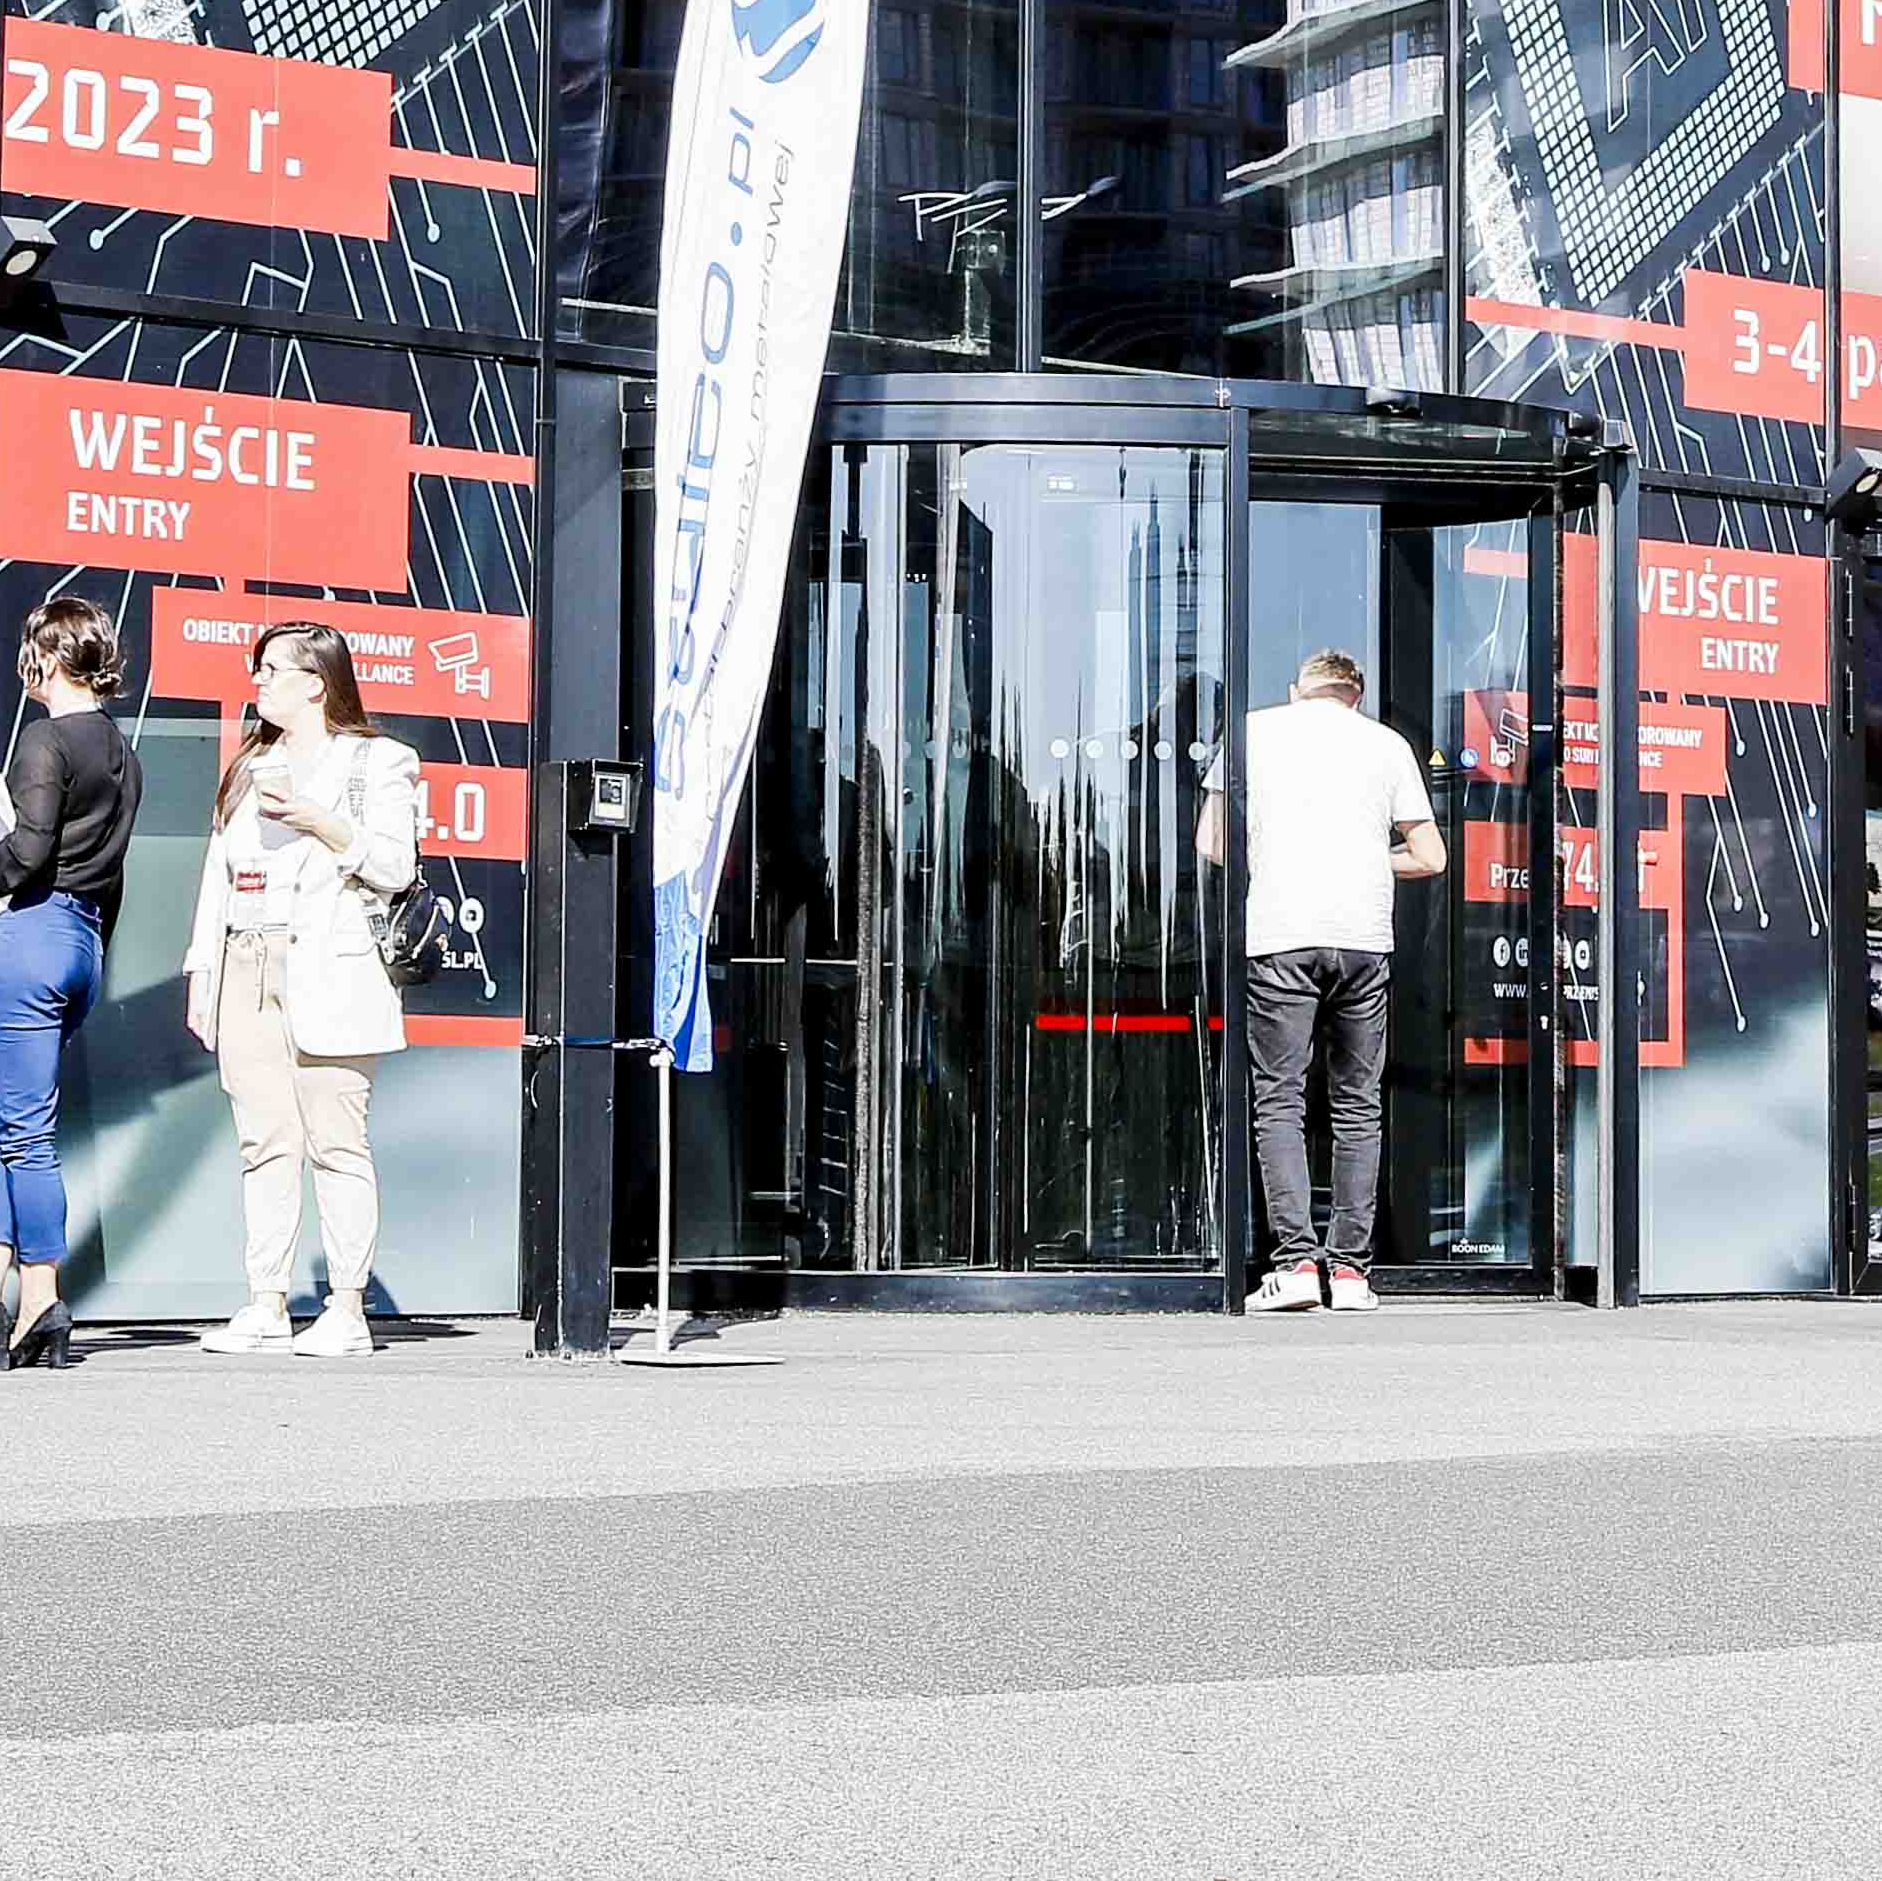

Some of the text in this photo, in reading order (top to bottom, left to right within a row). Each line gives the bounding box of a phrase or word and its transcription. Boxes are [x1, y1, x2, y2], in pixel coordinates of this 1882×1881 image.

[4, 59, 214, 165] 2023
[249, 109, 301, 177] r.
[1732, 308, 1822, 383] 3-4
[69, 405, 316, 491] WEJŚCIE
[66, 492, 191, 541] ENTRY
[182, 618, 254, 645] OBIEKT
[1701, 637, 1780, 675] ENTRY
